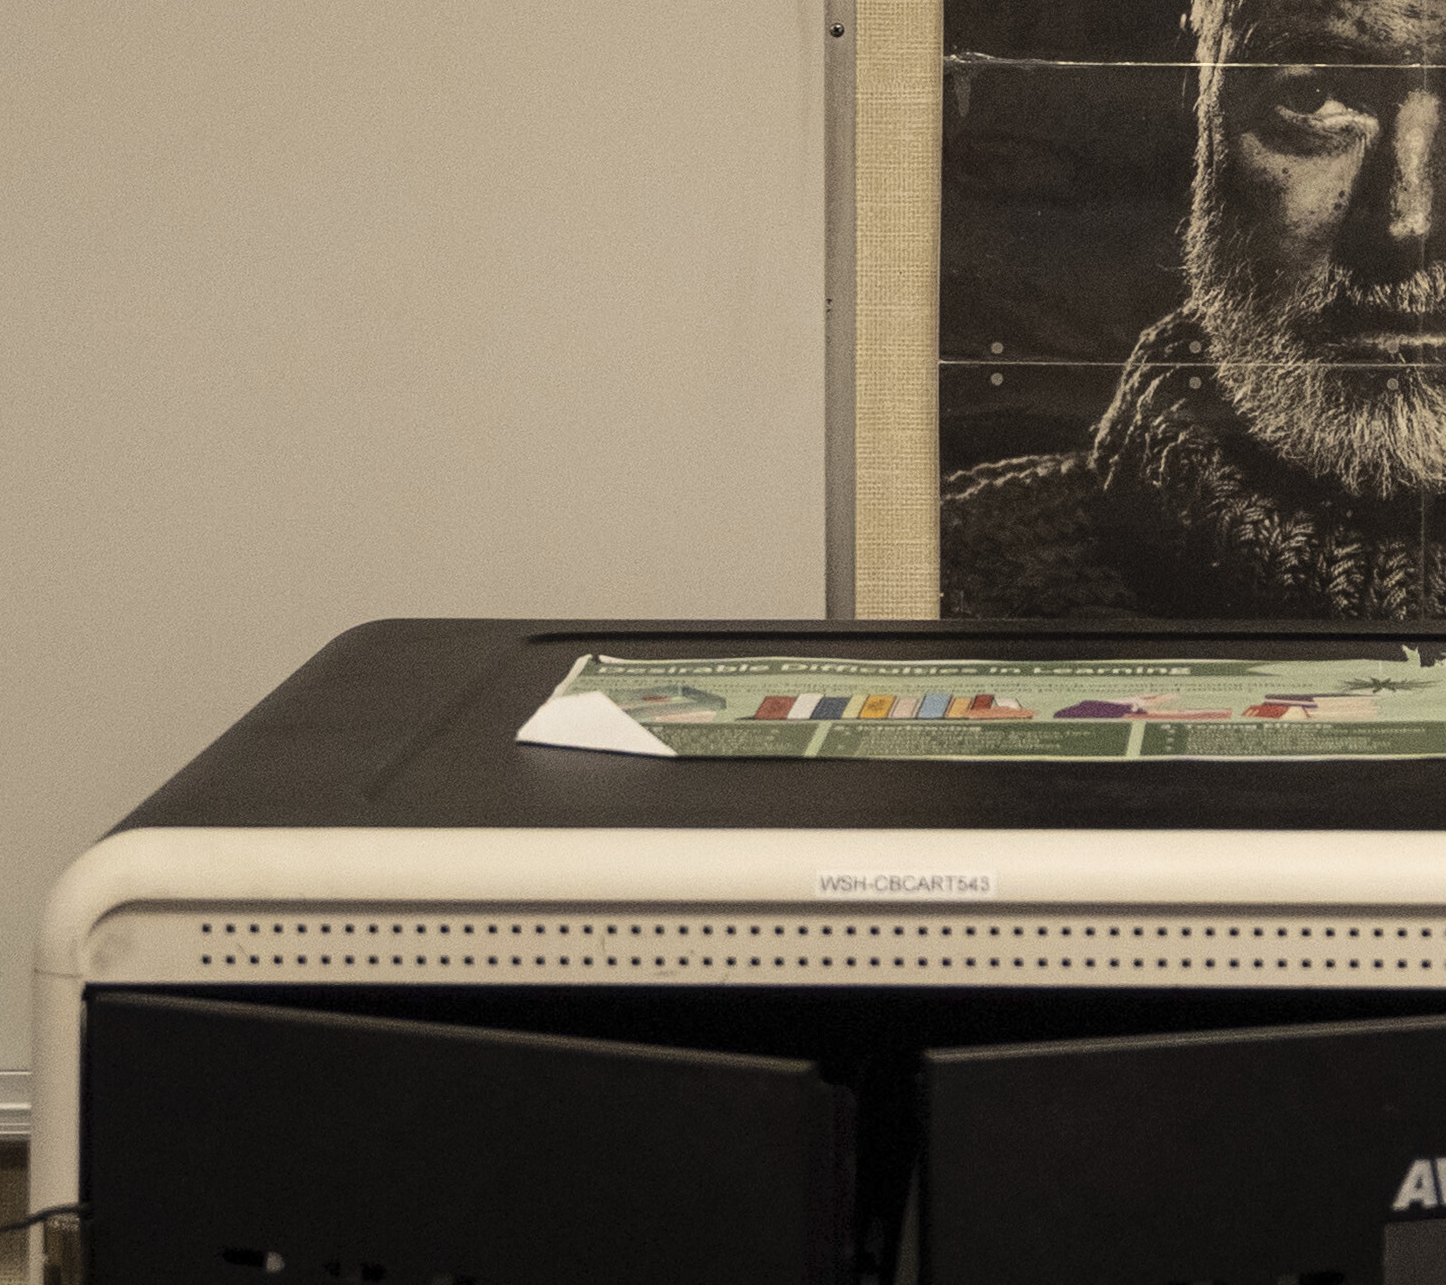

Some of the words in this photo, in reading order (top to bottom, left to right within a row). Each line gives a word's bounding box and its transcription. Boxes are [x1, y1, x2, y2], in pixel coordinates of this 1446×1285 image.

[598, 663, 770, 676] Desirable
[989, 663, 1021, 675] in
[1032, 664, 1191, 677] Learning
[820, 875, 990, 892] WSH-CBCART543
